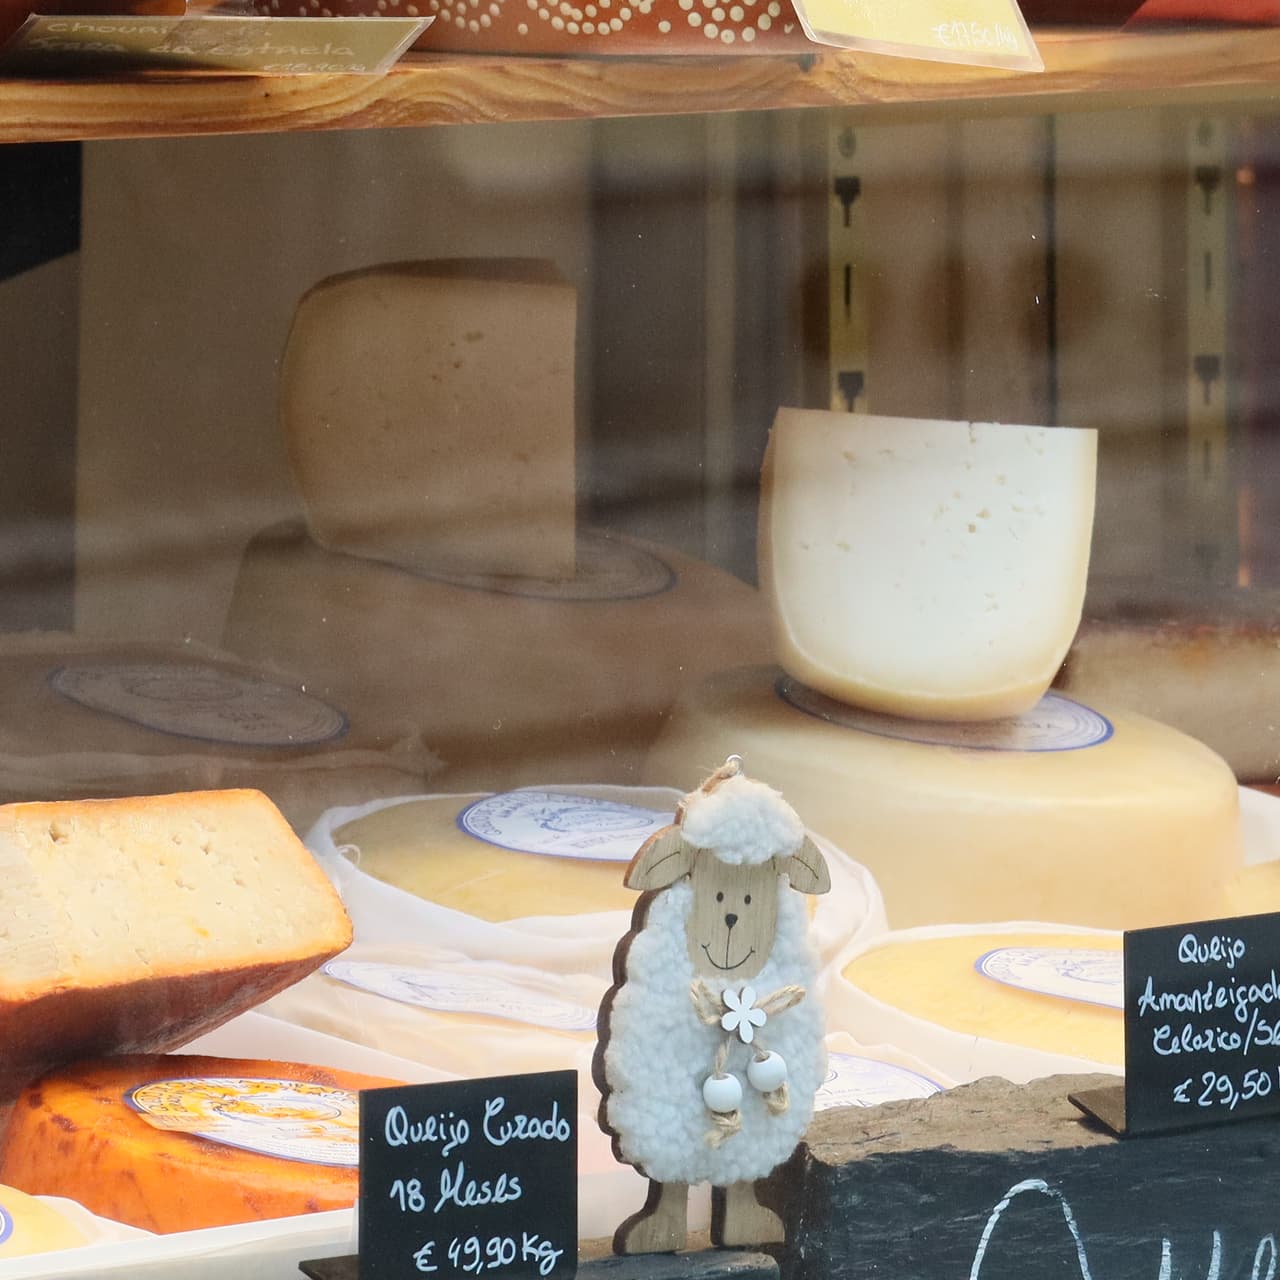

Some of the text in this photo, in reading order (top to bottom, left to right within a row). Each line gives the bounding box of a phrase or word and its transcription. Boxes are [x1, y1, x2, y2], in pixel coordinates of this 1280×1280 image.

[1177, 932, 1247, 970] Queijo
[384, 1105, 470, 1158] Queijo
[482, 1096, 571, 1147] Curado
[389, 1160, 523, 1214] 18 Meses
